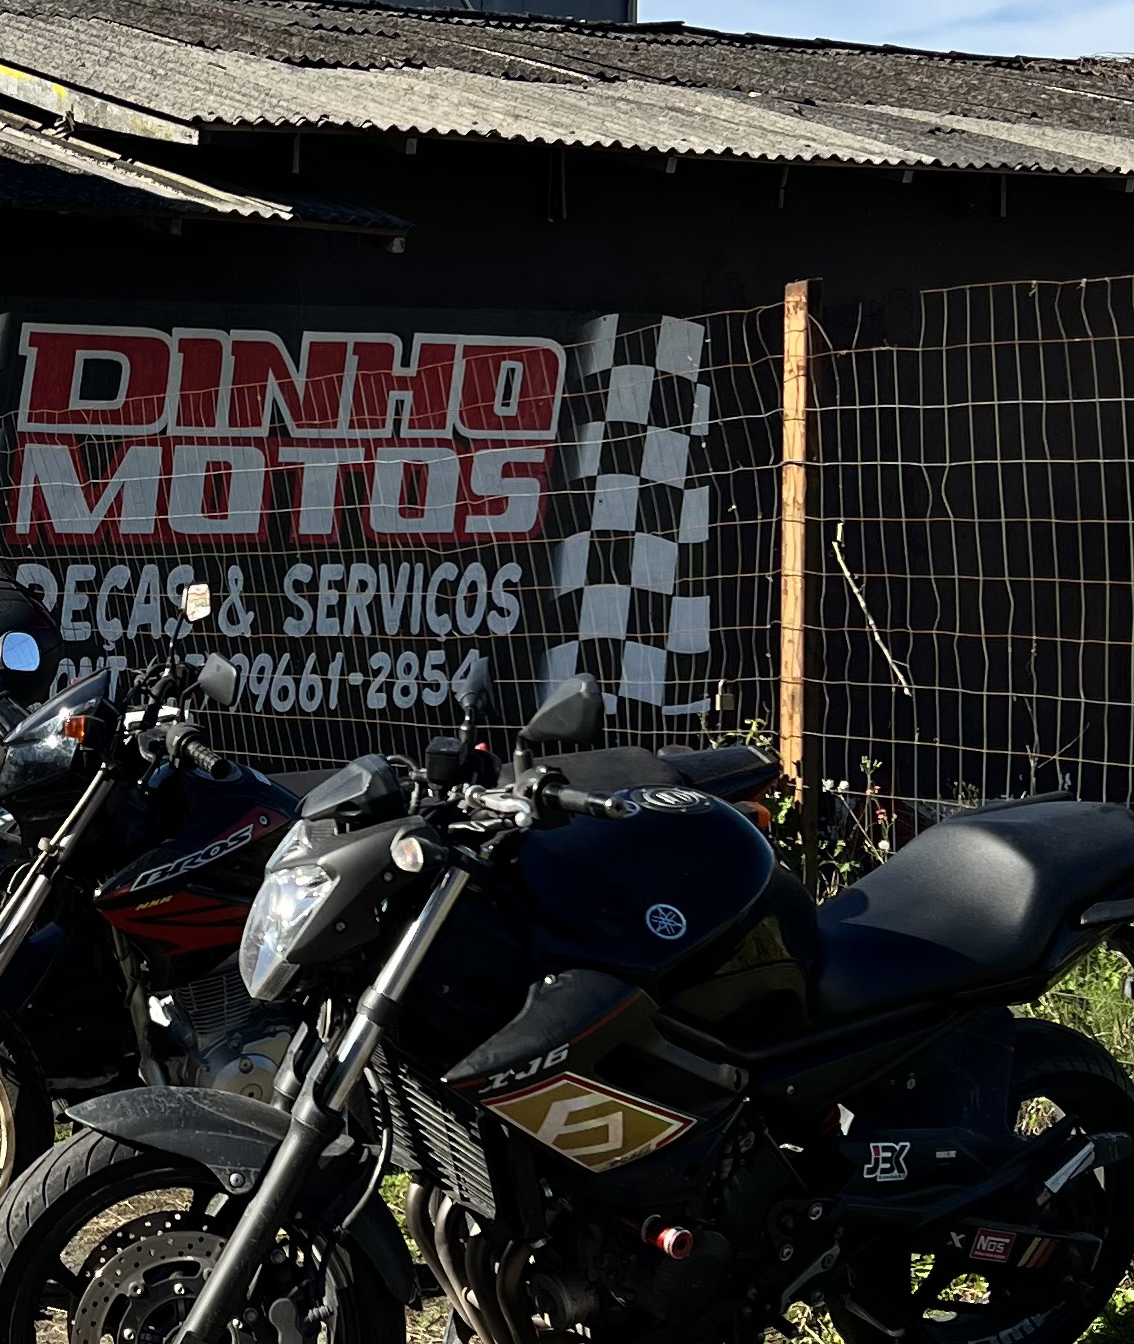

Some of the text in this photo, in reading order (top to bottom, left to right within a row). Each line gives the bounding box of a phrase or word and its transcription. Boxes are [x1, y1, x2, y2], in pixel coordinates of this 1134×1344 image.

[18, 322, 567, 439] DINHO
[12, 443, 549, 538] MOTOS
[16, 562, 523, 650] PEÇAS & SERVIÇOS
[130, 824, 254, 892] BROS
[976, 1234, 1011, 1254] NOS
